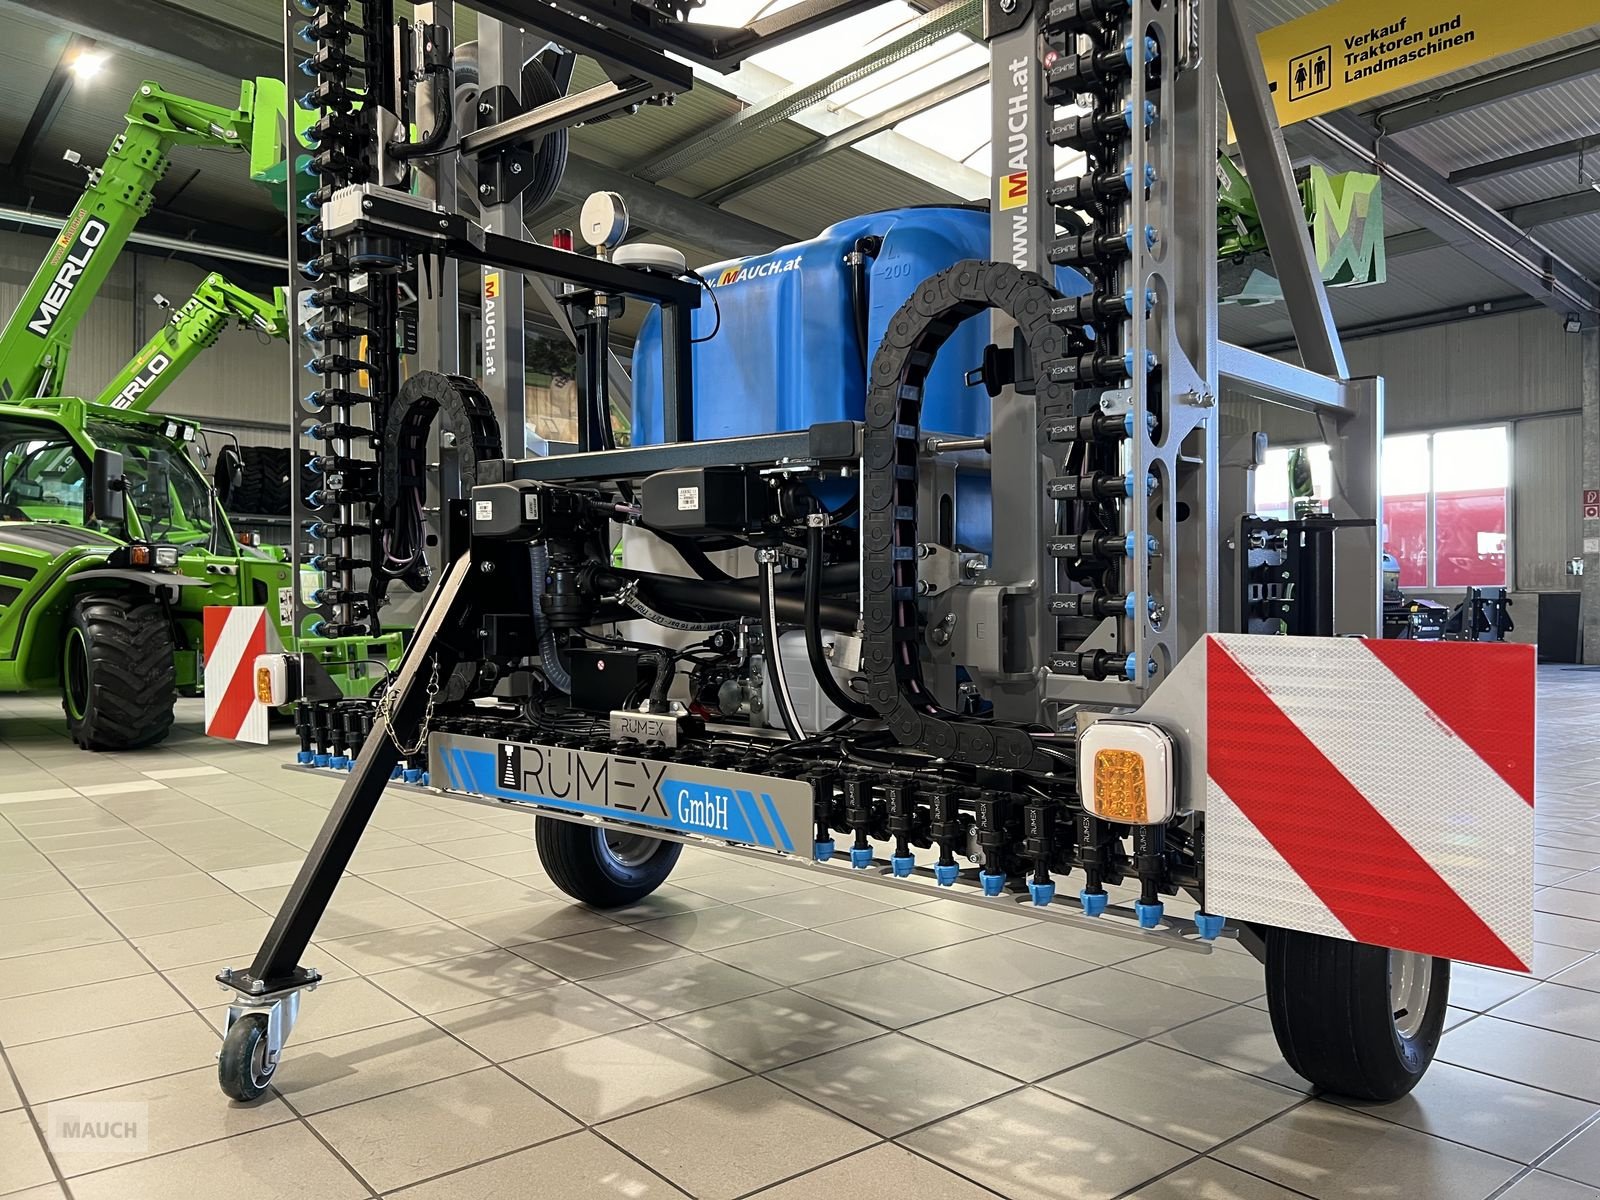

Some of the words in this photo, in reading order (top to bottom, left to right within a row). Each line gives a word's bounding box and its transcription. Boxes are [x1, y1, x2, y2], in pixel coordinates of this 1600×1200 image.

[1344, 17, 1407, 49] Verkauf
[1344, 31, 1423, 66] Traktoren
[1429, 15, 1461, 37] und
[1345, 31, 1475, 83] Landmaschinen
[28, 219, 106, 335] MERLO
[884, 263, 912, 280] 200
[109, 354, 169, 410] ERLO
[677, 789, 729, 830] GmbH
